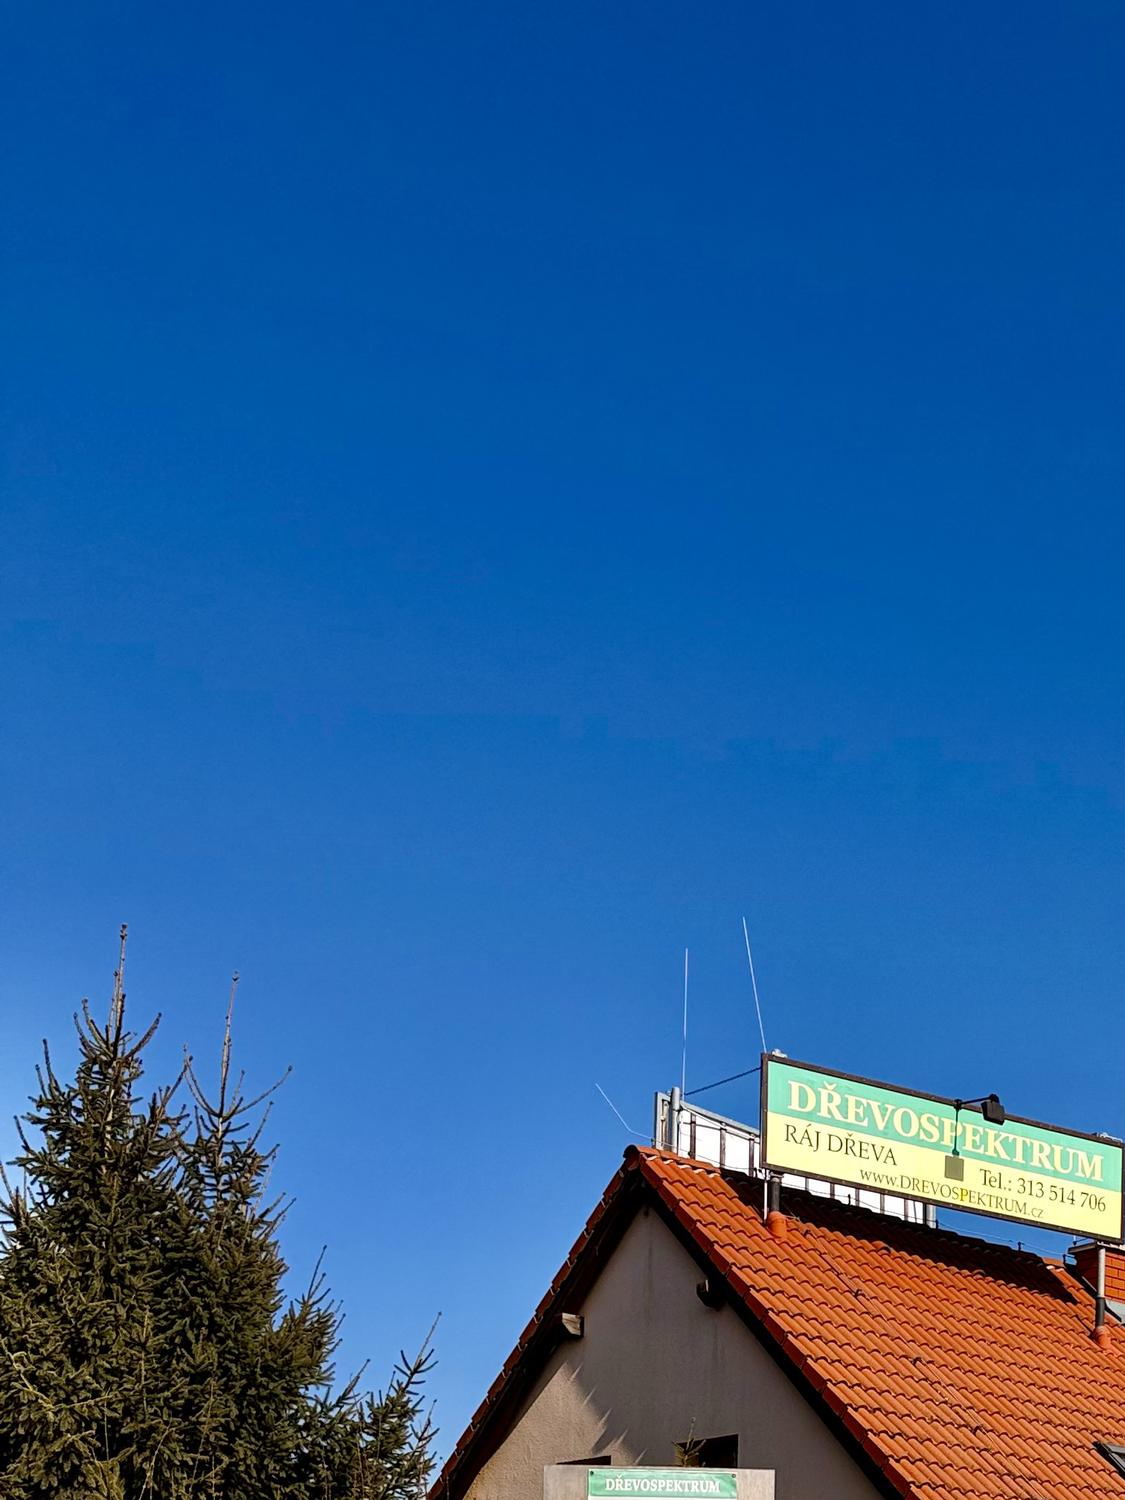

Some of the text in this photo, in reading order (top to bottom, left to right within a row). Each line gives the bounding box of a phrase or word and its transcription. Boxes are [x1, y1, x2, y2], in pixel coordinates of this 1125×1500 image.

[785, 1123, 898, 1166] RÁJ DŘEVA
[788, 1080, 1105, 1183] DŘEVOSPEKTRUM
[860, 1169, 1045, 1219] www.DREVOSPEKTRUM.cz
[979, 1168, 1106, 1213] Tel.: 313 514 706
[605, 1475, 721, 1494] DŘEVOSPEKTRUM
